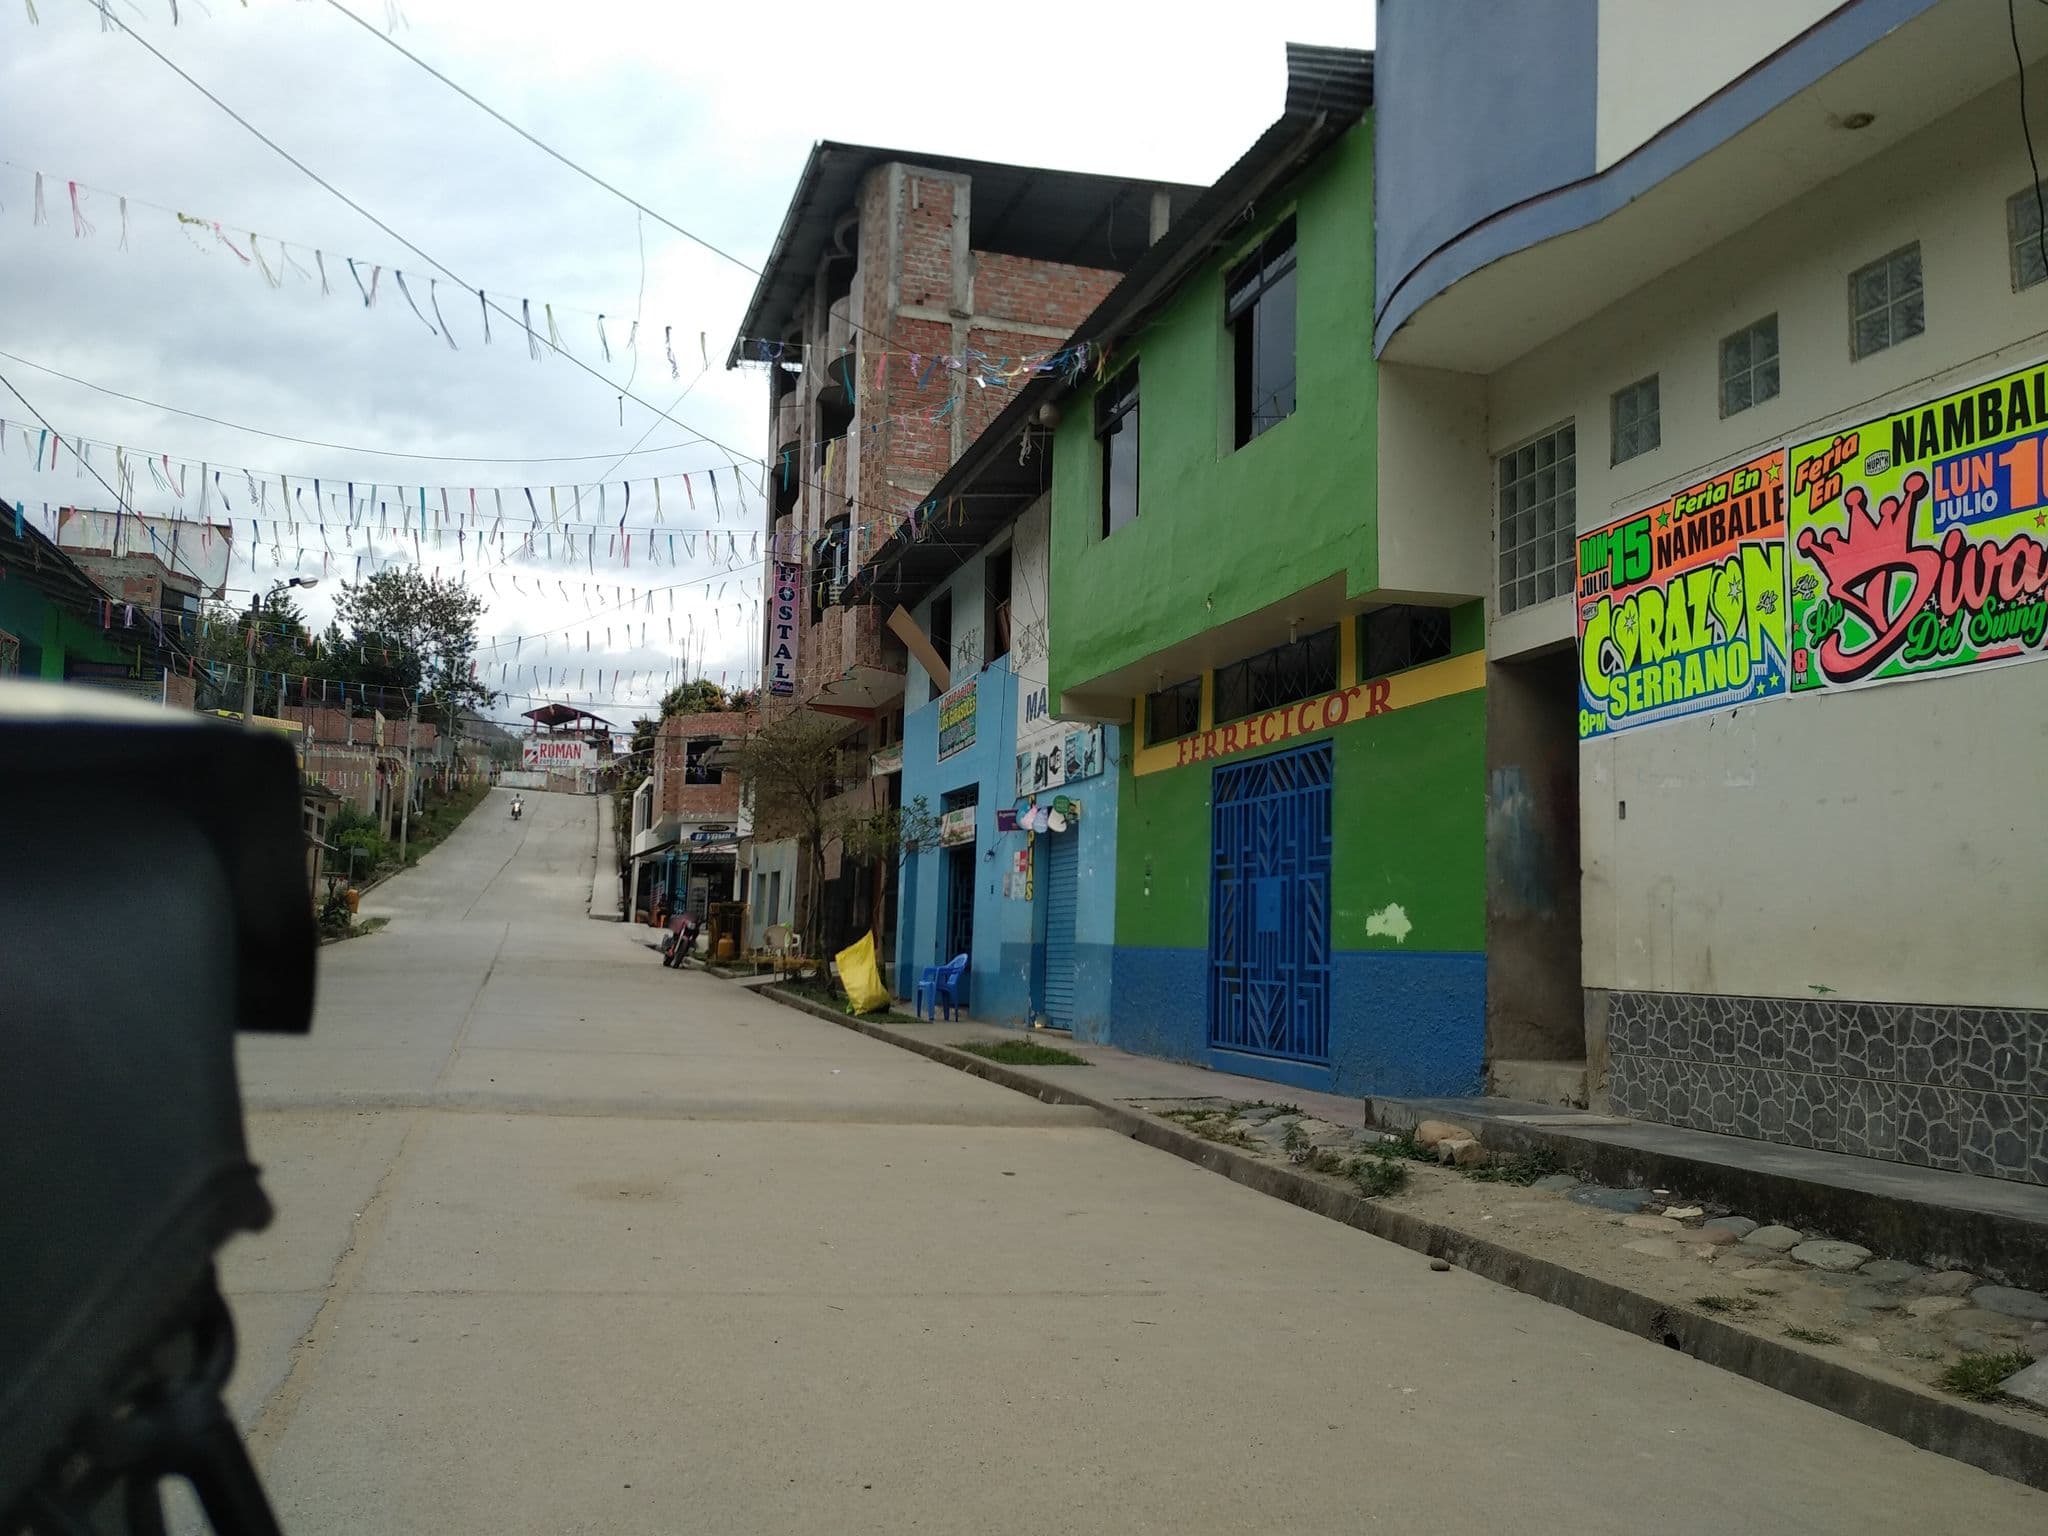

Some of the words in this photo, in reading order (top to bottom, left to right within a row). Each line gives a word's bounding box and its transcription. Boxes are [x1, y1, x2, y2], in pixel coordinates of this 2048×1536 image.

[1794, 432, 1860, 497] Feria
[1935, 452, 1994, 501] LUN
[1998, 437, 2048, 510] 1
[1673, 481, 1728, 522] Feria
[1731, 468, 1762, 497] En
[1809, 472, 1844, 515] En
[1936, 489, 1999, 525] JULIO
[1580, 530, 1608, 578] DOM
[1607, 516, 1653, 588] 15
[1657, 485, 1785, 571] NAMBALLE
[1580, 571, 1609, 598] JULIO
[774, 566, 796, 679] HOSTAL
[1583, 545, 1786, 698] CORAZON
[1807, 600, 1844, 648] Las
[1902, 608, 1965, 663] Del
[1968, 596, 2048, 648] Swing
[1609, 640, 1750, 717] SERRANO
[1793, 648, 1808, 673] 8
[1026, 686, 1048, 724] MA
[1579, 708, 1606, 738] 8PM
[540, 743, 582, 760] ROMAN
